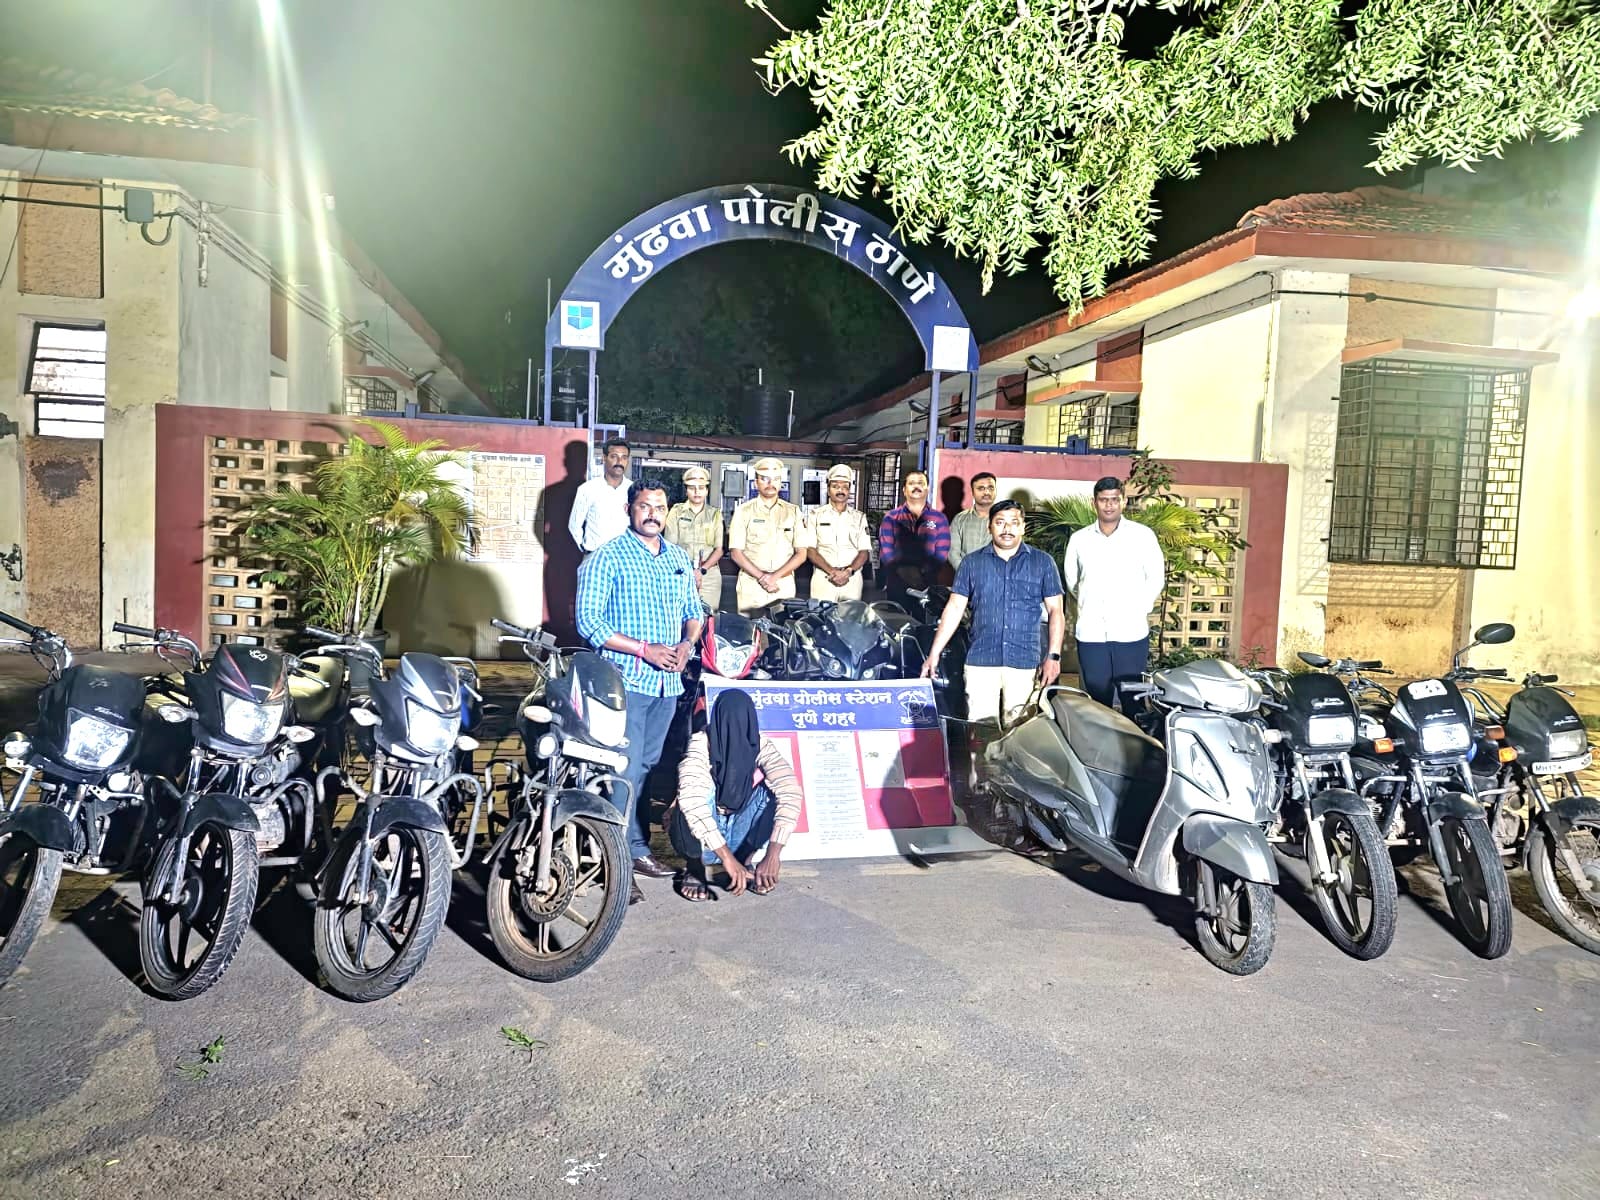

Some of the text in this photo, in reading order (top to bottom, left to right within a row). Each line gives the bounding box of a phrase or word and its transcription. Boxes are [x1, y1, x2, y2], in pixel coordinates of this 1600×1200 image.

[602, 184, 939, 306] मुंढवा पोलीस ठाणे
[793, 689, 841, 706] पोलीस
[845, 689, 892, 705] स्टेशन
[791, 710, 857, 729] पुणे शहर
